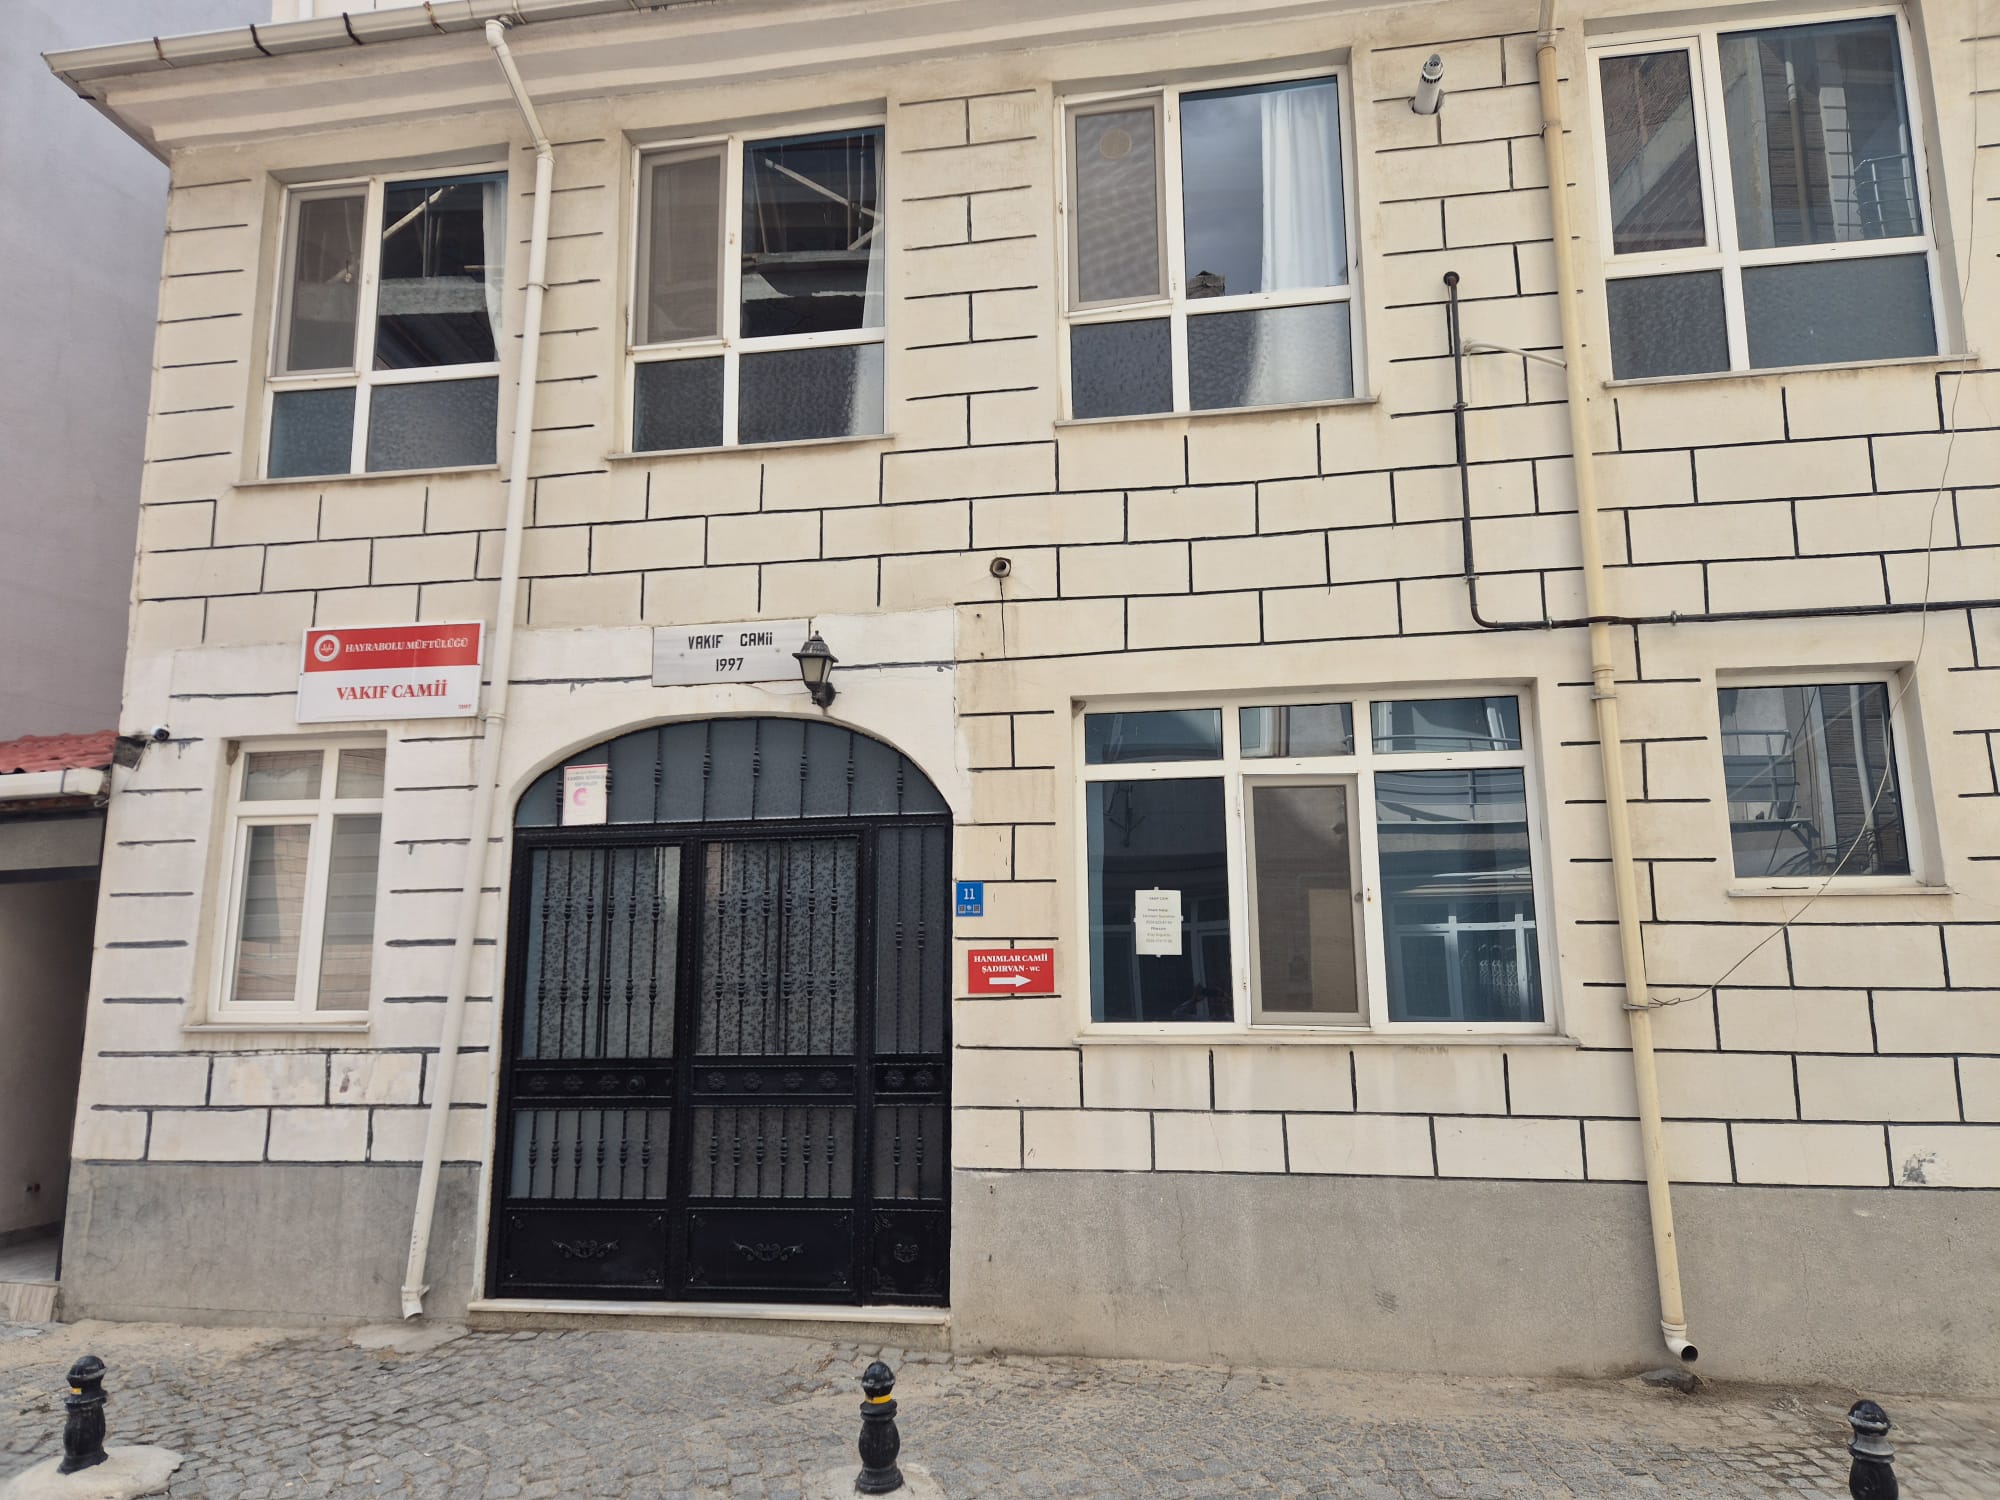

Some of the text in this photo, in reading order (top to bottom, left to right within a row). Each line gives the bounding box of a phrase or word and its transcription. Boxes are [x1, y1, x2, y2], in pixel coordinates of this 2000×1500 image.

[345, 641, 405, 652] HAYRABOLU
[688, 635, 723, 649] VAKIF
[716, 657, 744, 672] 1997
[336, 679, 448, 700] VAKIF CAMİİ
[964, 888, 975, 900] 11
[1022, 953, 1048, 962] CAMİİ
[982, 965, 1025, 974] ŞADIRVAN
